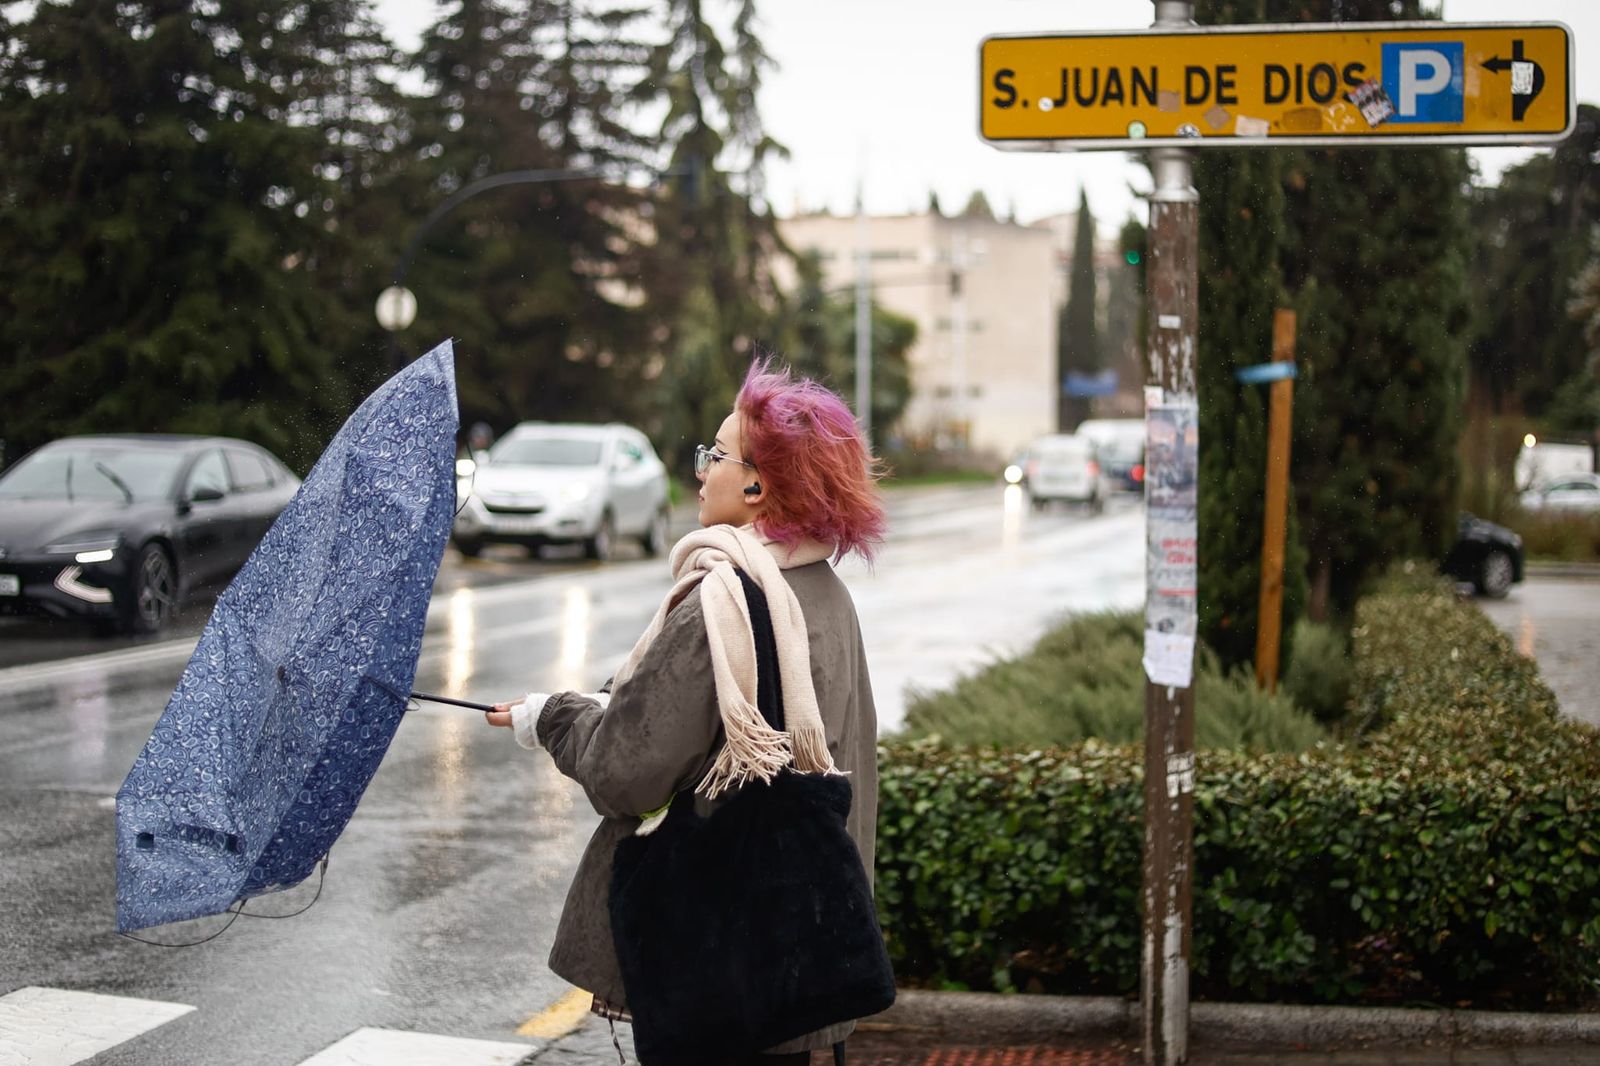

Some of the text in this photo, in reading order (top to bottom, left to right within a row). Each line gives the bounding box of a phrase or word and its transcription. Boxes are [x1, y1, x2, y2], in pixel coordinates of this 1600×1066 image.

[993, 68, 1028, 109] S.
[1052, 66, 1157, 107] JUAN
[1185, 64, 1238, 105] DE
[1263, 62, 1366, 105] DIOS
[1399, 49, 1451, 116] P
